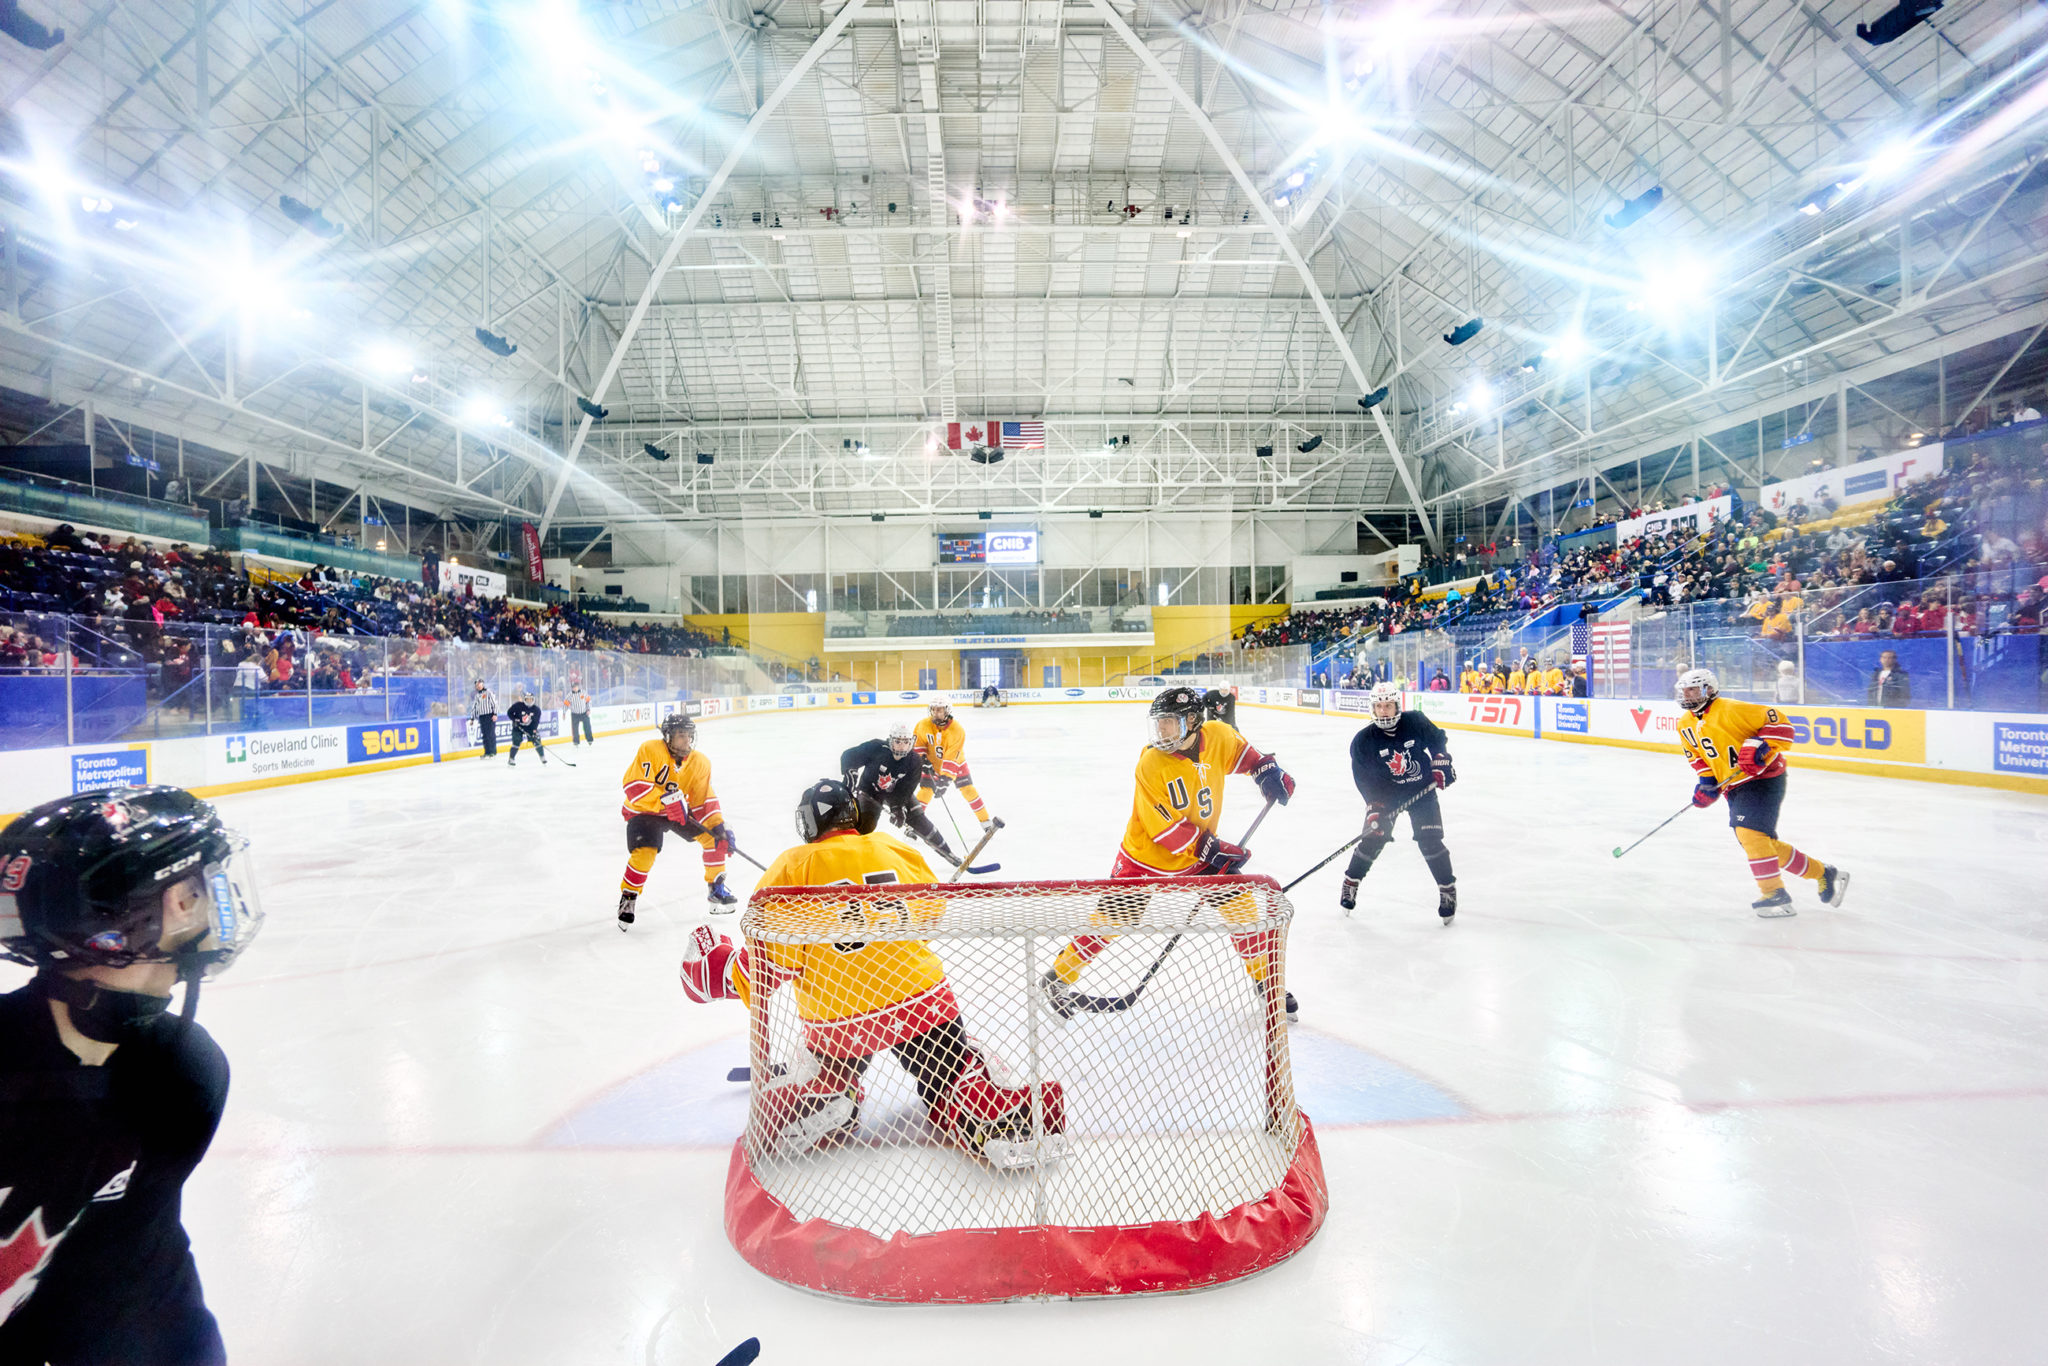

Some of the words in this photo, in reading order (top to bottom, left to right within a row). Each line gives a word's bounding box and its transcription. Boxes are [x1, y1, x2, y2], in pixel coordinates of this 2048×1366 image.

[993, 537, 1025, 551] CNIB
[1468, 696, 1521, 725] TSN
[1558, 704, 1575, 714] Toronto
[1767, 708, 1778, 723] 8
[1558, 714, 1587, 722] Metropolitan
[1558, 720, 1581, 730] University
[250, 736, 308, 756] Cleveland
[310, 733, 339, 750] Clinic
[362, 727, 419, 756] BOLD
[76, 757, 118, 769] Toronto
[252, 762, 279, 774] Sports
[281, 757, 315, 770] Medicine
[642, 762, 651, 778] 7
[76, 765, 143, 781] Metropolitan
[77, 778, 131, 793] University
[154, 851, 202, 881] CCM
